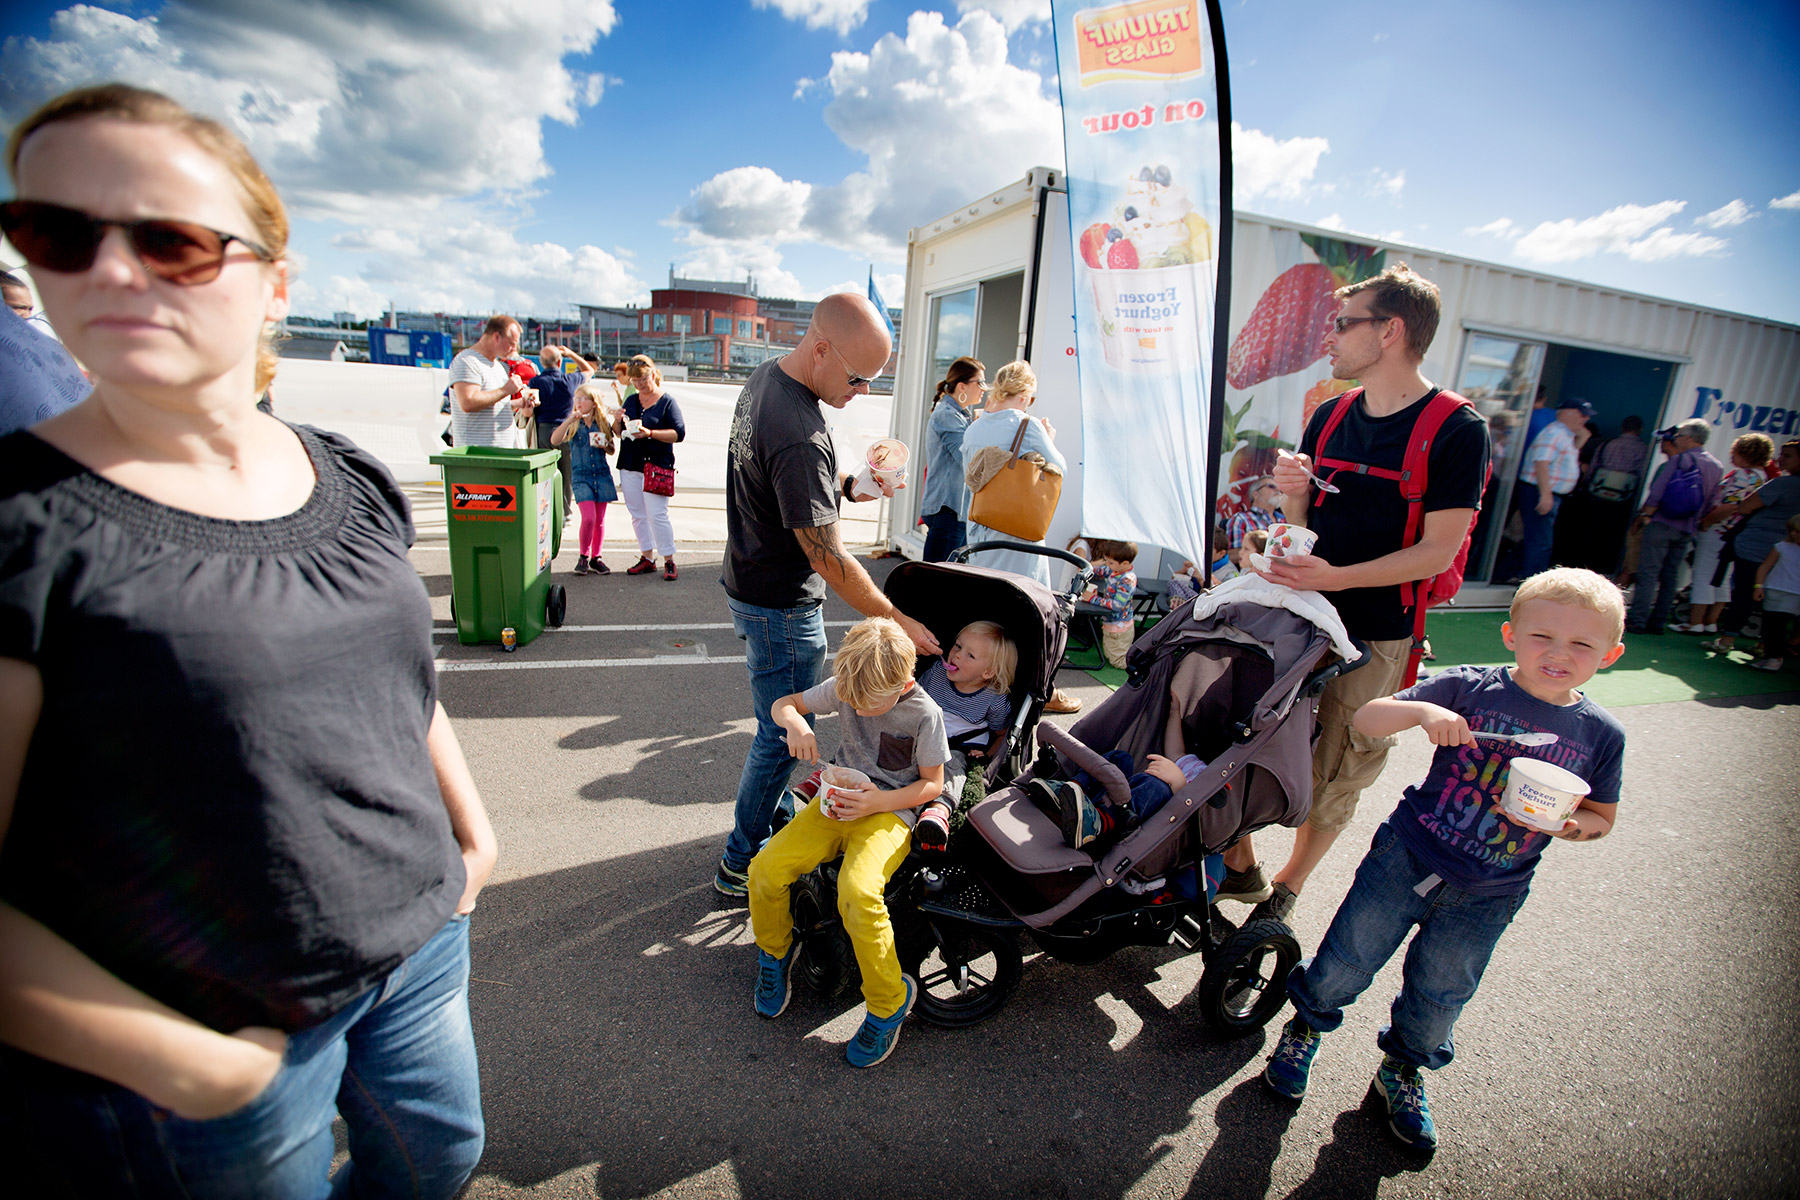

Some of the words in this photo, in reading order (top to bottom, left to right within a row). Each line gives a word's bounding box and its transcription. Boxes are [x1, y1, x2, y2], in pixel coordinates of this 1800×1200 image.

[1687, 386, 1800, 436] Frozen
[456, 493, 493, 501] ALLFRAKT
[1499, 712, 1512, 722] THE
[1470, 714, 1588, 771] BALTMORE
[1518, 787, 1557, 808] Yoghurt
[1523, 783, 1556, 802] Frozen
[1418, 813, 1465, 847] EAST
[1463, 839, 1515, 870] COAST
